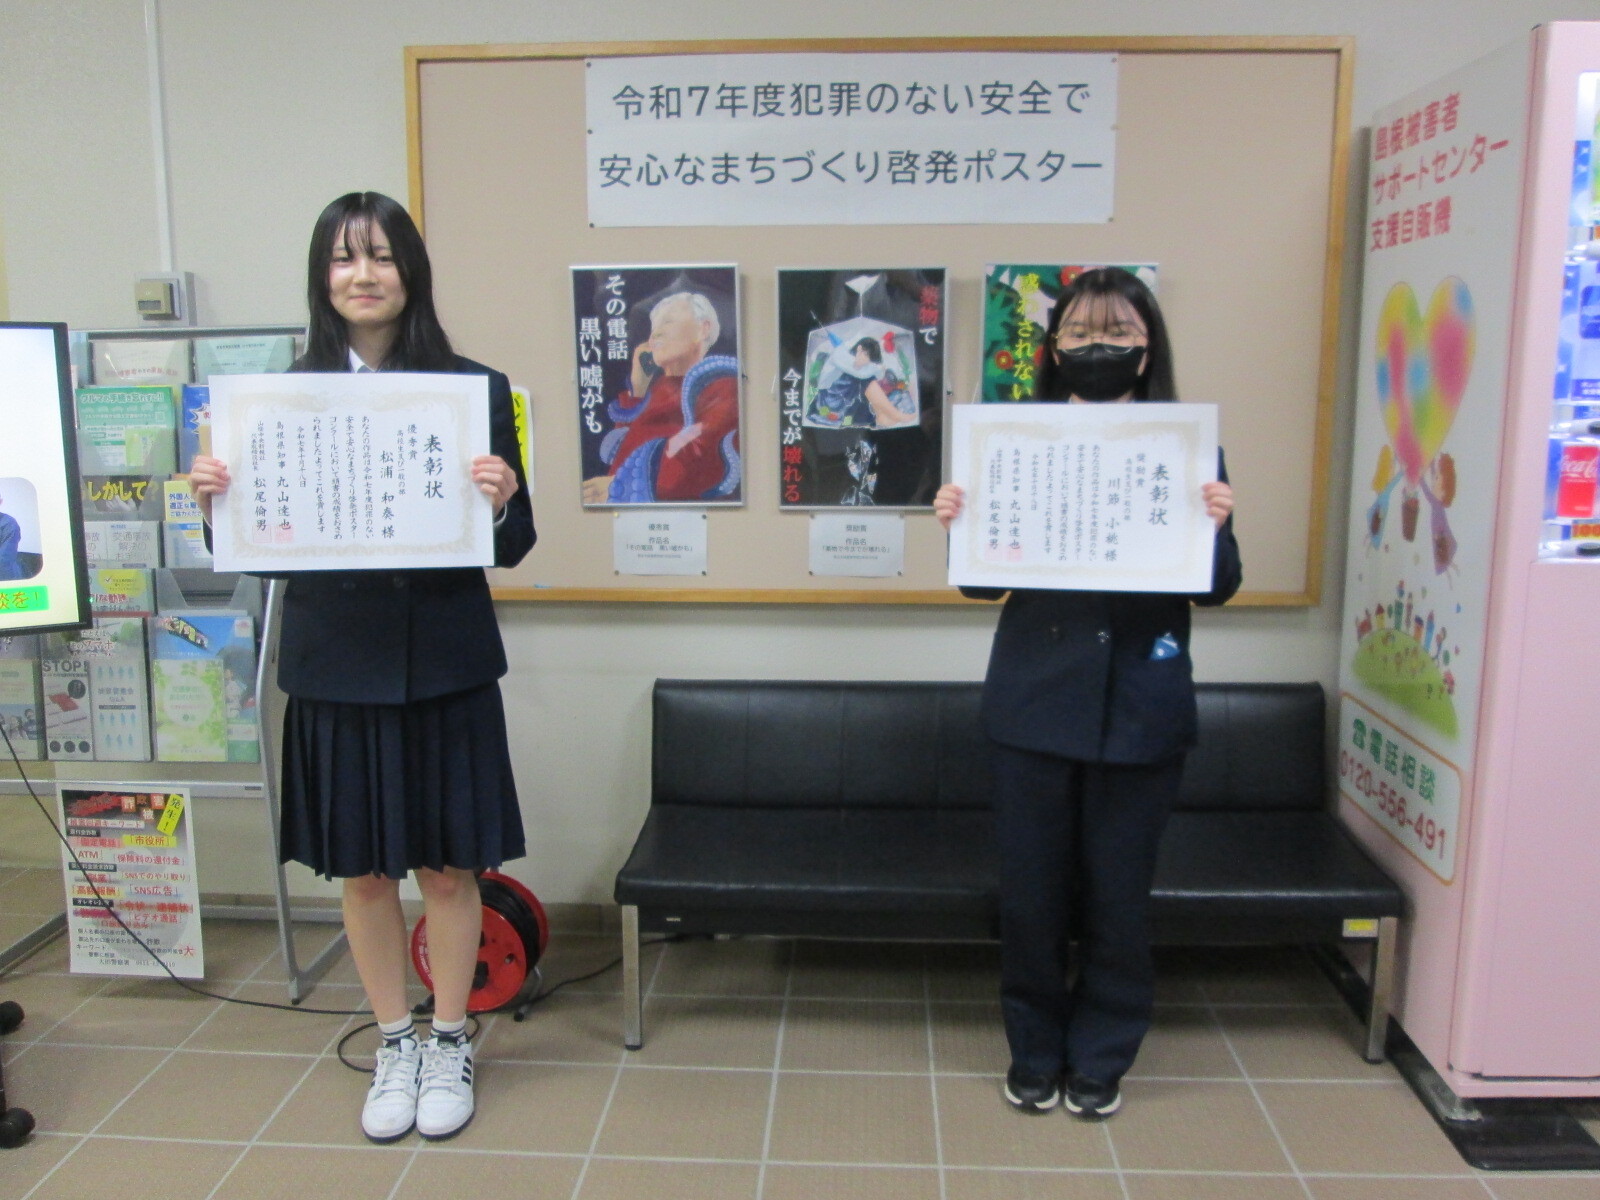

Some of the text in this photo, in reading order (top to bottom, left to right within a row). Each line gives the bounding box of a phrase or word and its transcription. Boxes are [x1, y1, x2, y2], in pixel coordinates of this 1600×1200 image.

[612, 80, 1091, 120] 令和7年度犯罪のない安全で
[599, 149, 1103, 187] 安心なまちづくり啓発ポスター
[1372, 133, 1509, 205] サポートセンター
[1370, 195, 1452, 252] 支援自販機
[606, 275, 628, 361] その電話
[579, 317, 604, 434] 黒い嘘かも
[407, 423, 418, 461] 優秀賞
[423, 434, 445, 499] 表彰状
[782, 367, 804, 503] 今までが壊れる
[277, 476, 292, 531] 丸山達也
[1148, 463, 1170, 526] 表彰状
[1339, 749, 1447, 860] 0120-556-491
